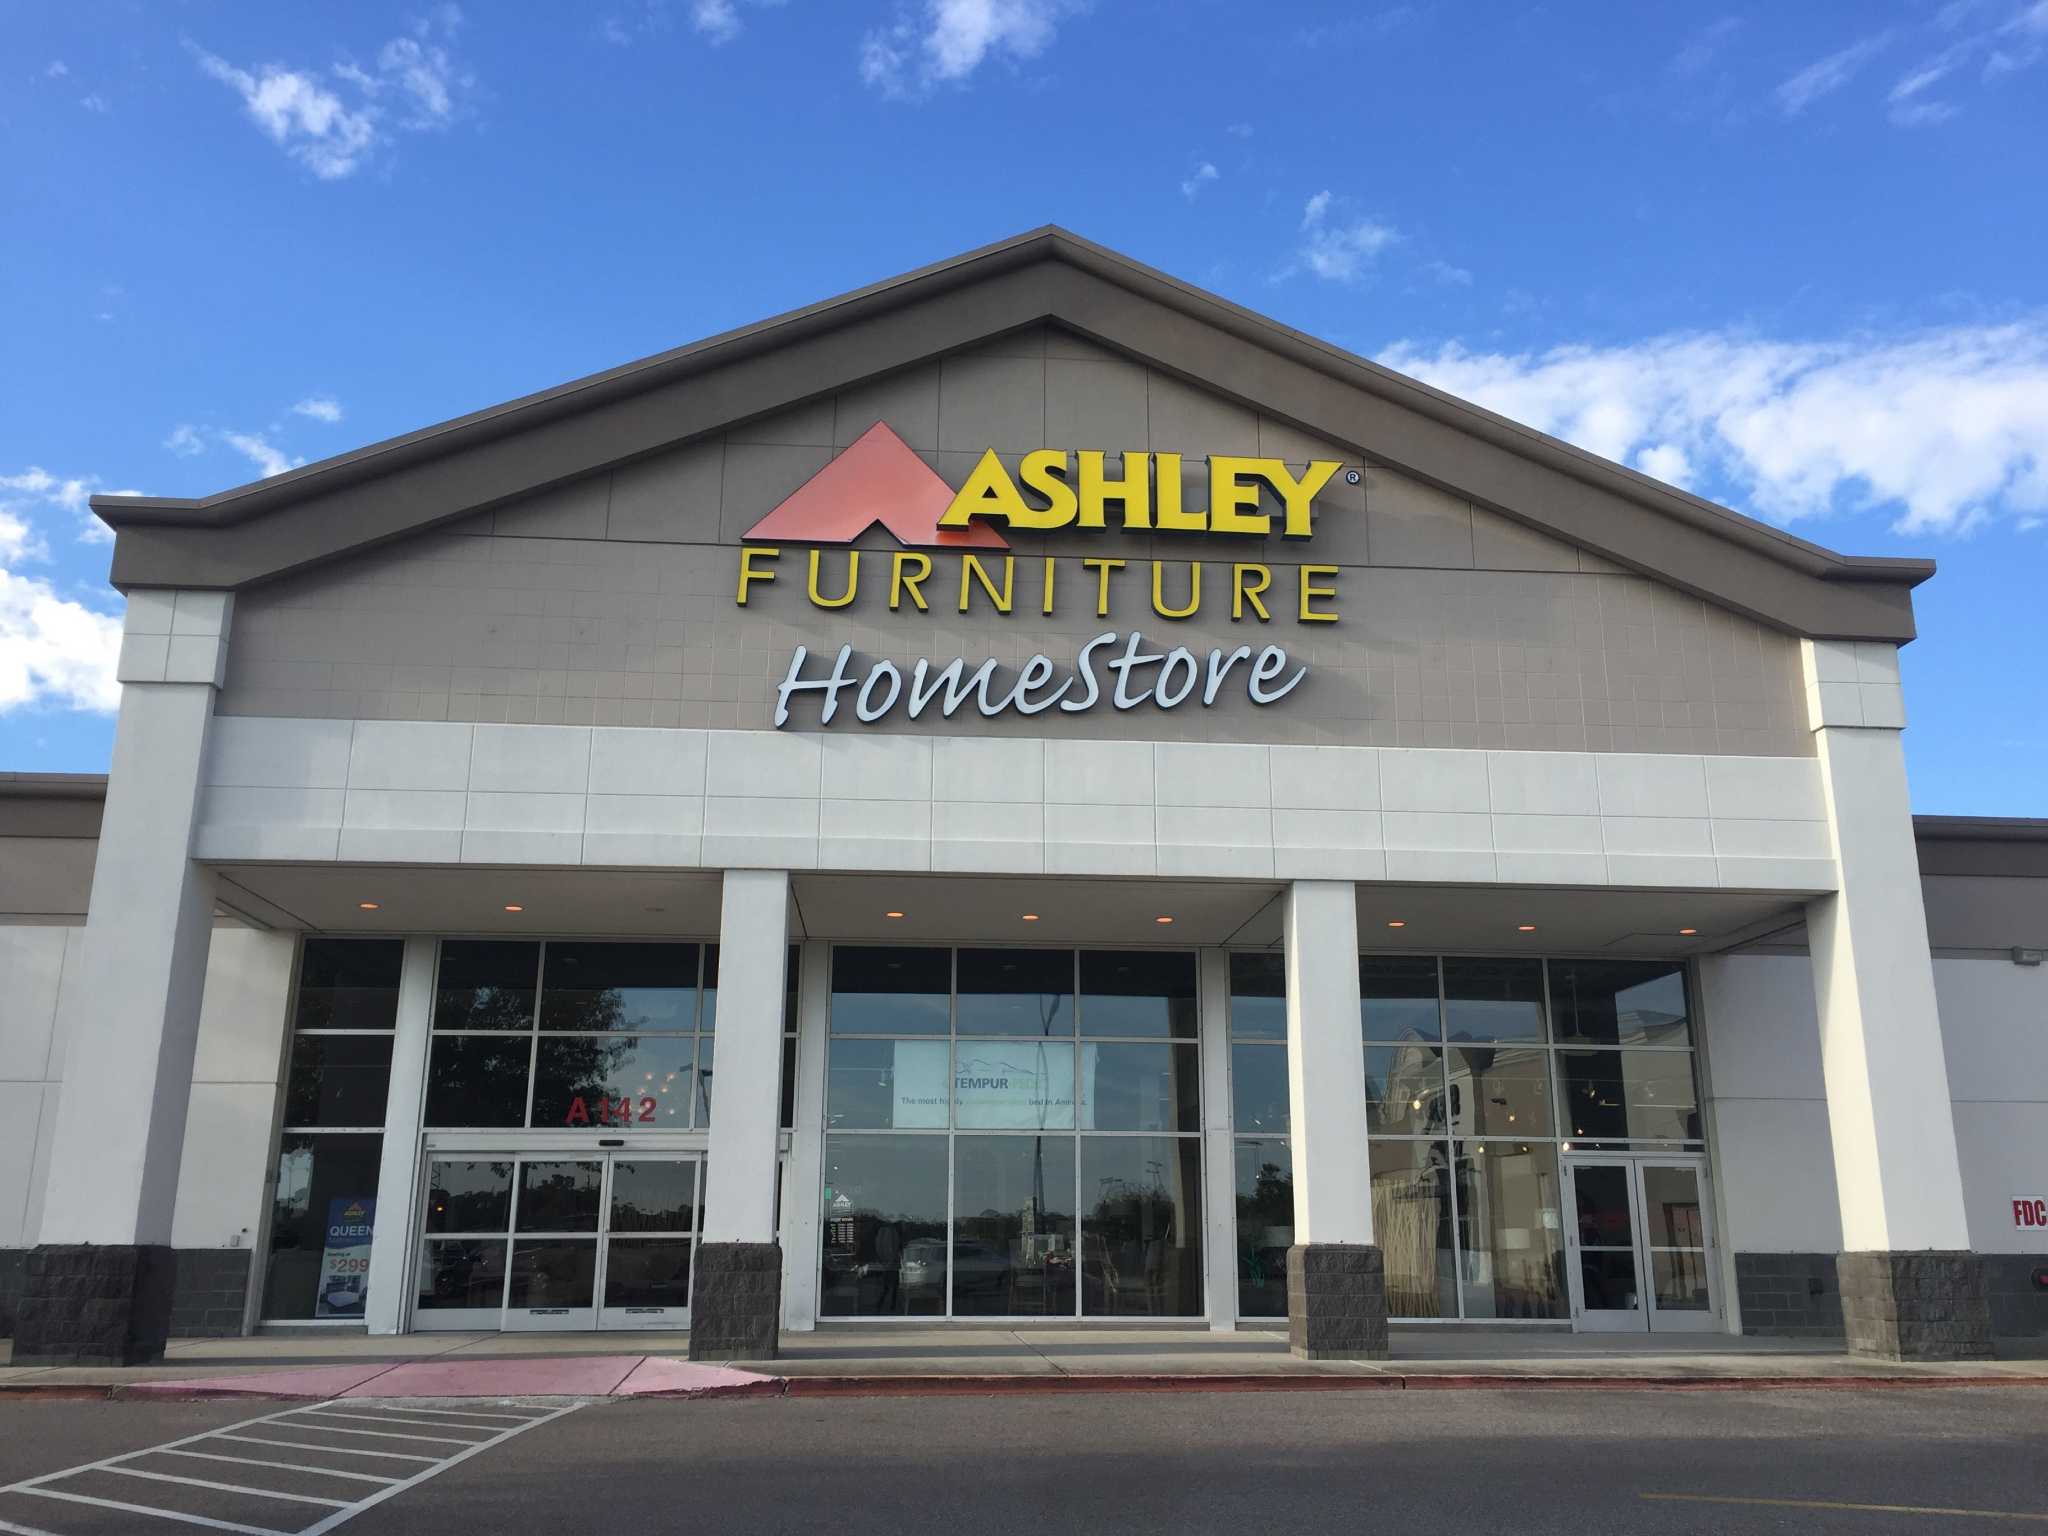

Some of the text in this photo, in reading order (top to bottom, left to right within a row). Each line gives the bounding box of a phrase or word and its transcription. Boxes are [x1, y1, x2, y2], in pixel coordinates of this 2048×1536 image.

[936, 448, 1343, 541] ASHLEY
[736, 547, 1340, 623] FURNITURE
[774, 631, 1307, 729] HomeStore
[563, 1096, 657, 1125] A142
[901, 1096, 916, 1105] The
[918, 1096, 938, 1105] most
[2013, 1200, 2047, 1226] FDC
